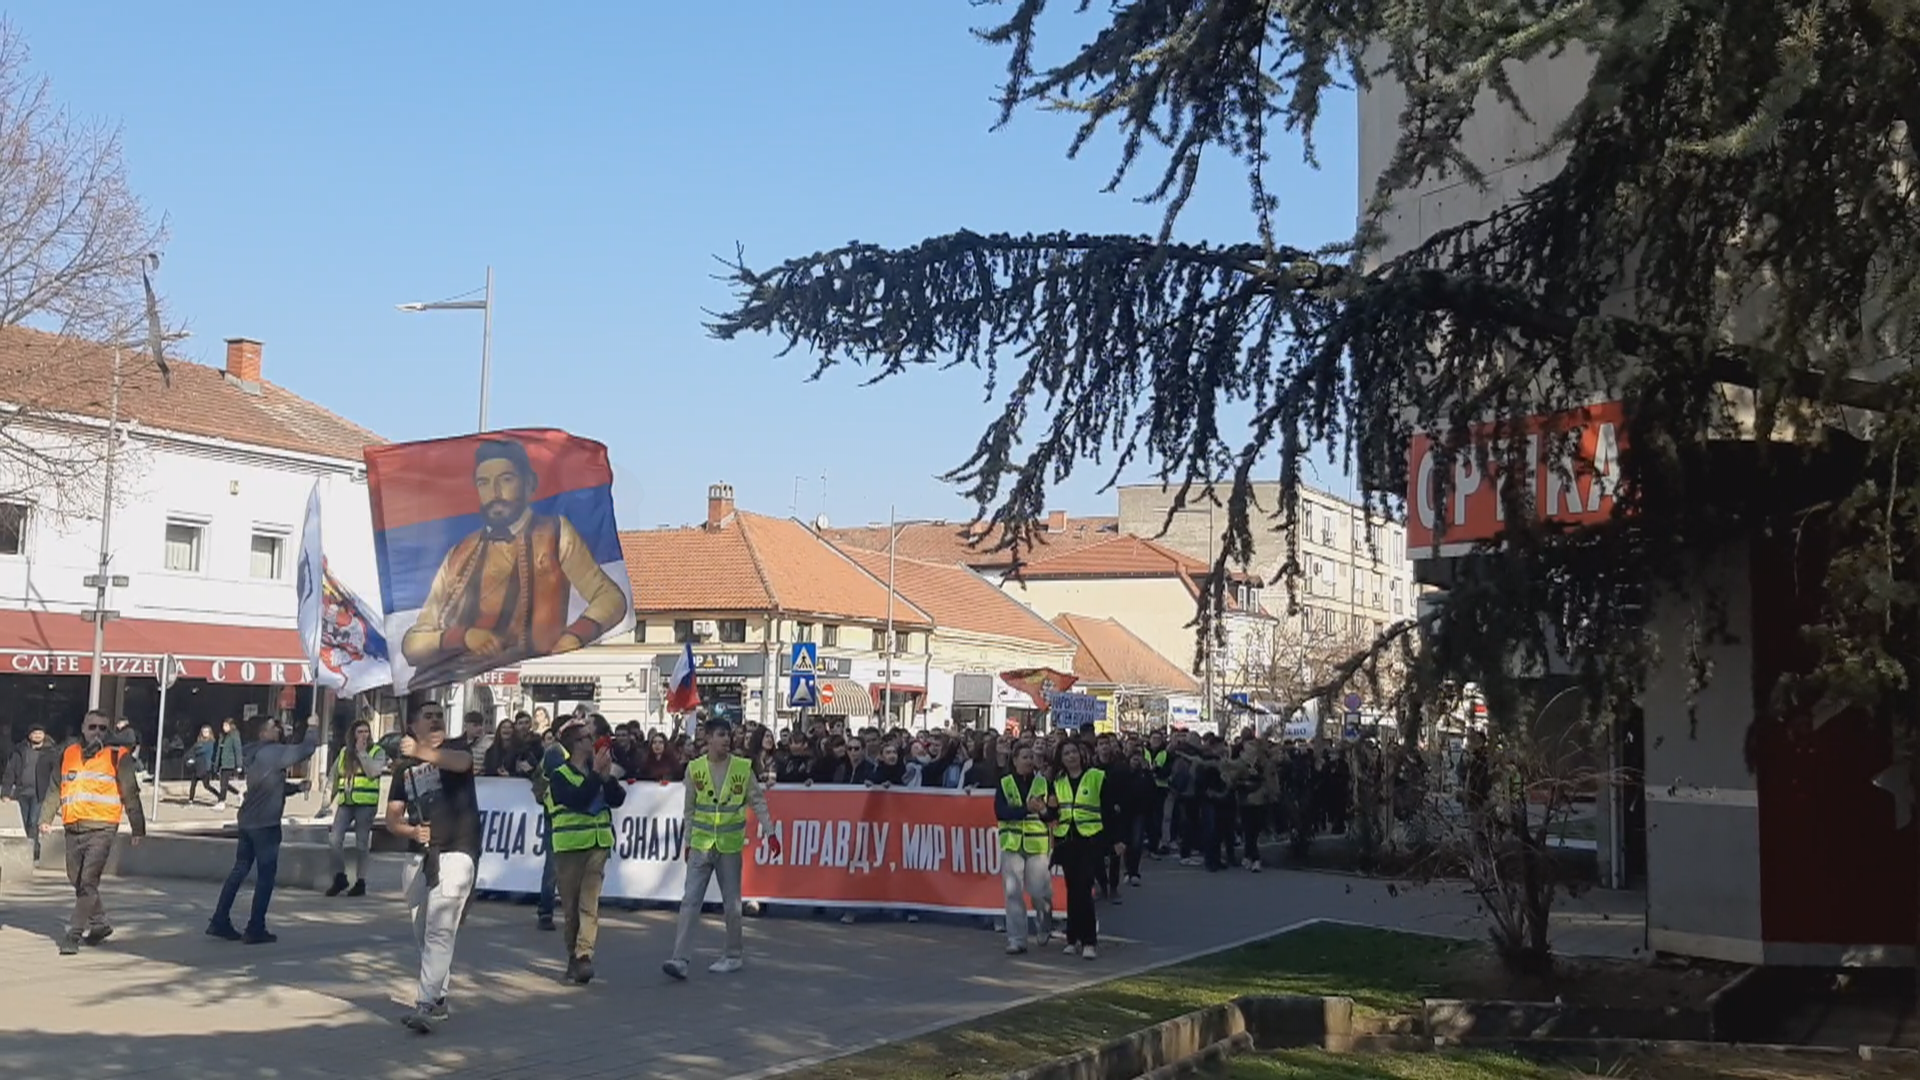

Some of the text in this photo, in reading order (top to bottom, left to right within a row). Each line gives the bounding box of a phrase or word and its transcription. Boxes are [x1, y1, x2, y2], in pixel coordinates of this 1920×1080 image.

[11, 653, 79, 671] CAFFE
[716, 655, 738, 667] TIM
[473, 671, 505, 684] AFFE
[902, 821, 947, 873] МИР
[950, 825, 967, 874] И
